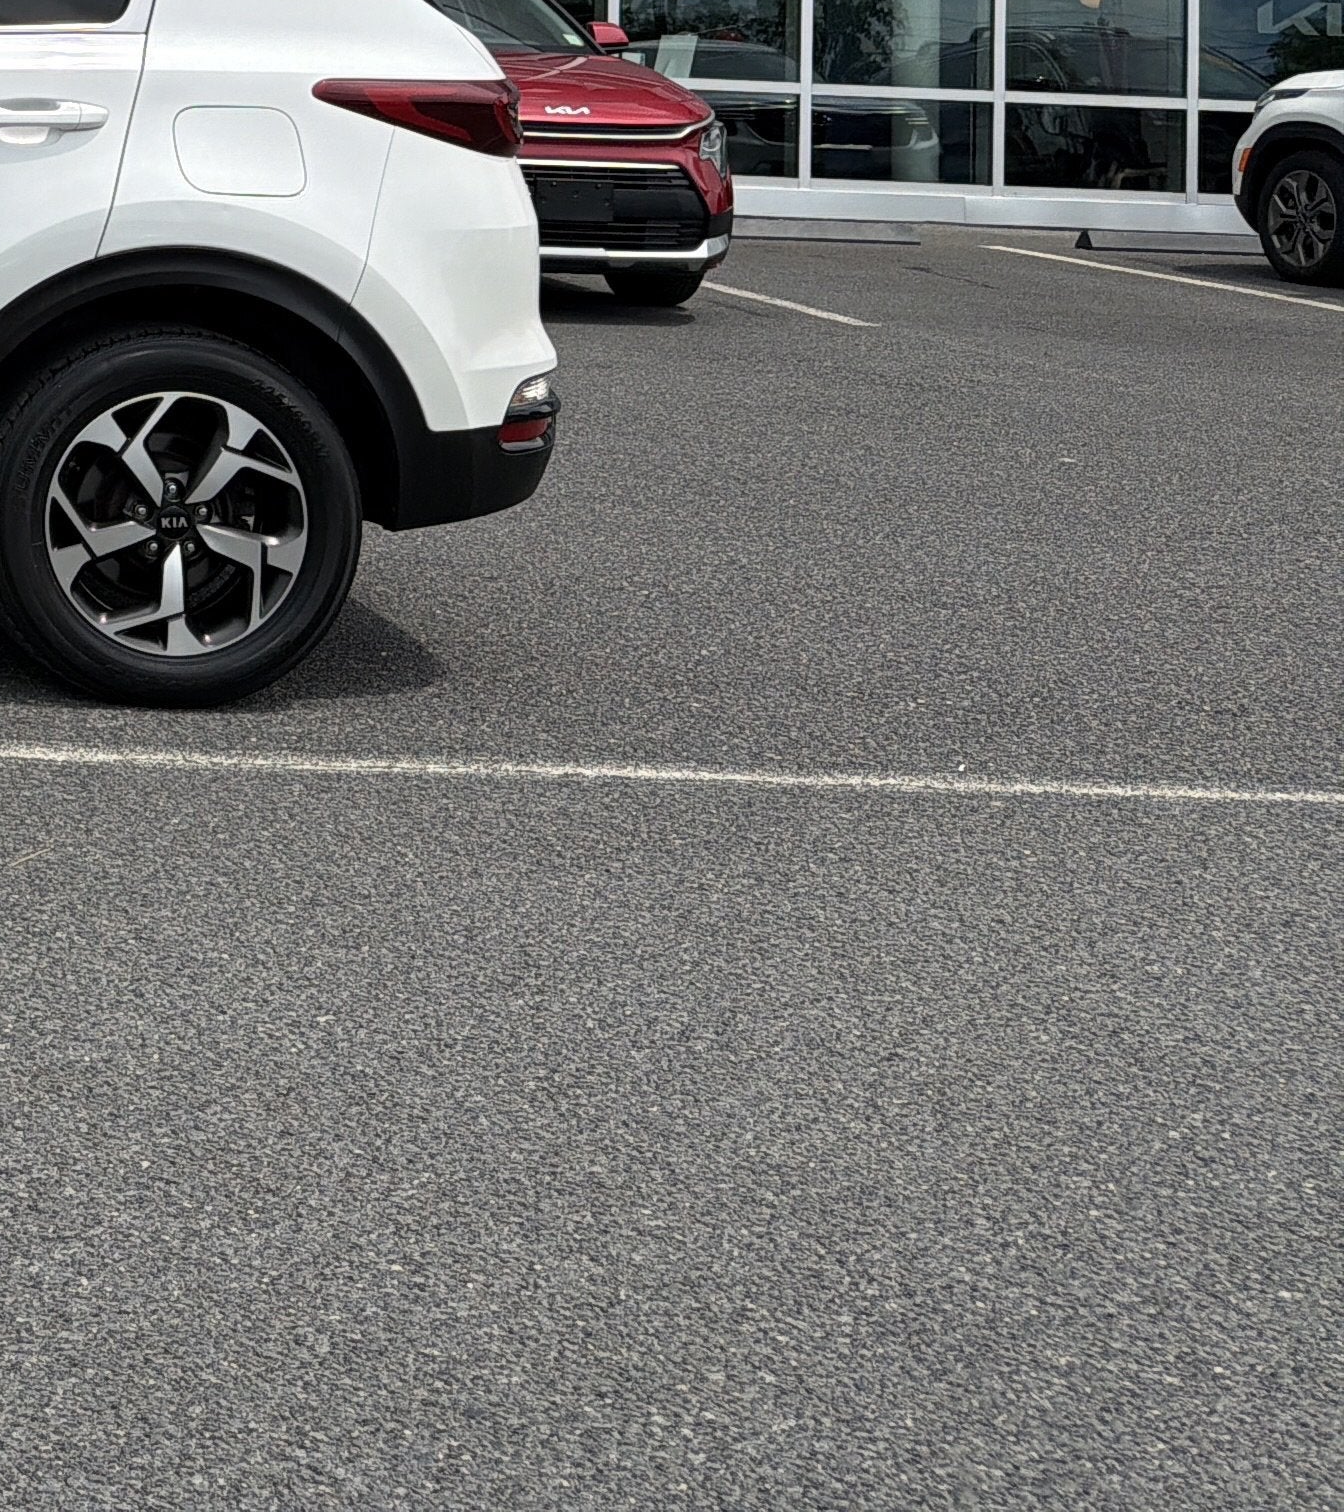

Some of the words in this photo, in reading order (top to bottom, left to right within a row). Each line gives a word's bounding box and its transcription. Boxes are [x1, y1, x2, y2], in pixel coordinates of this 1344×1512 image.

[1257, 0, 1344, 37] KI
[544, 104, 591, 115] KIA
[160, 516, 189, 529] KIA
